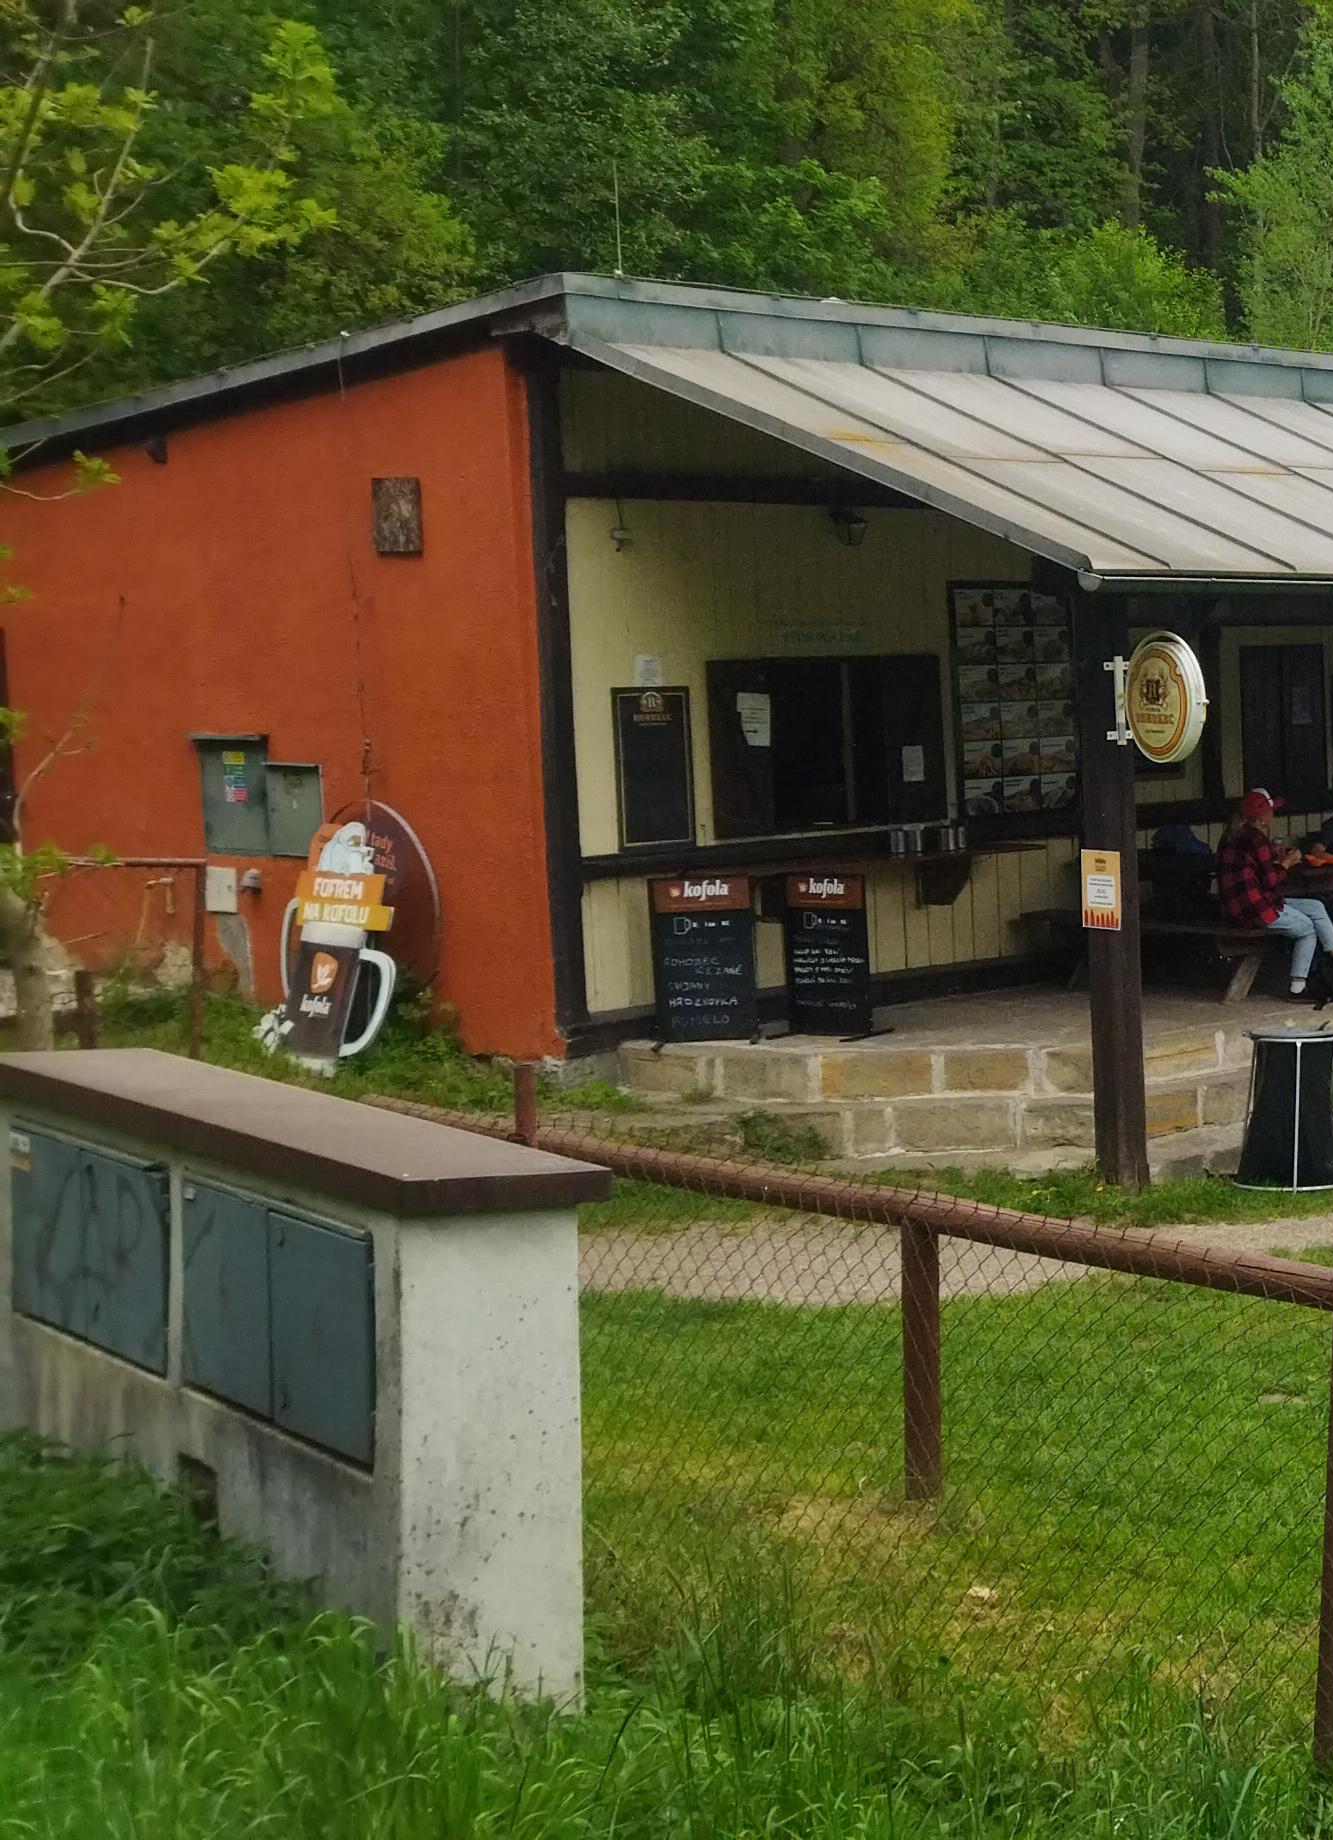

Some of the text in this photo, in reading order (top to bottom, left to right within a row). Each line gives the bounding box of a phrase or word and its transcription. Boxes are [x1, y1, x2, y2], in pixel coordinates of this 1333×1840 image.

[683, 880, 729, 901] kofola
[808, 878, 844, 898] kofola
[303, 902, 371, 924] NA KOFOLU
[300, 994, 332, 1018] kofola
